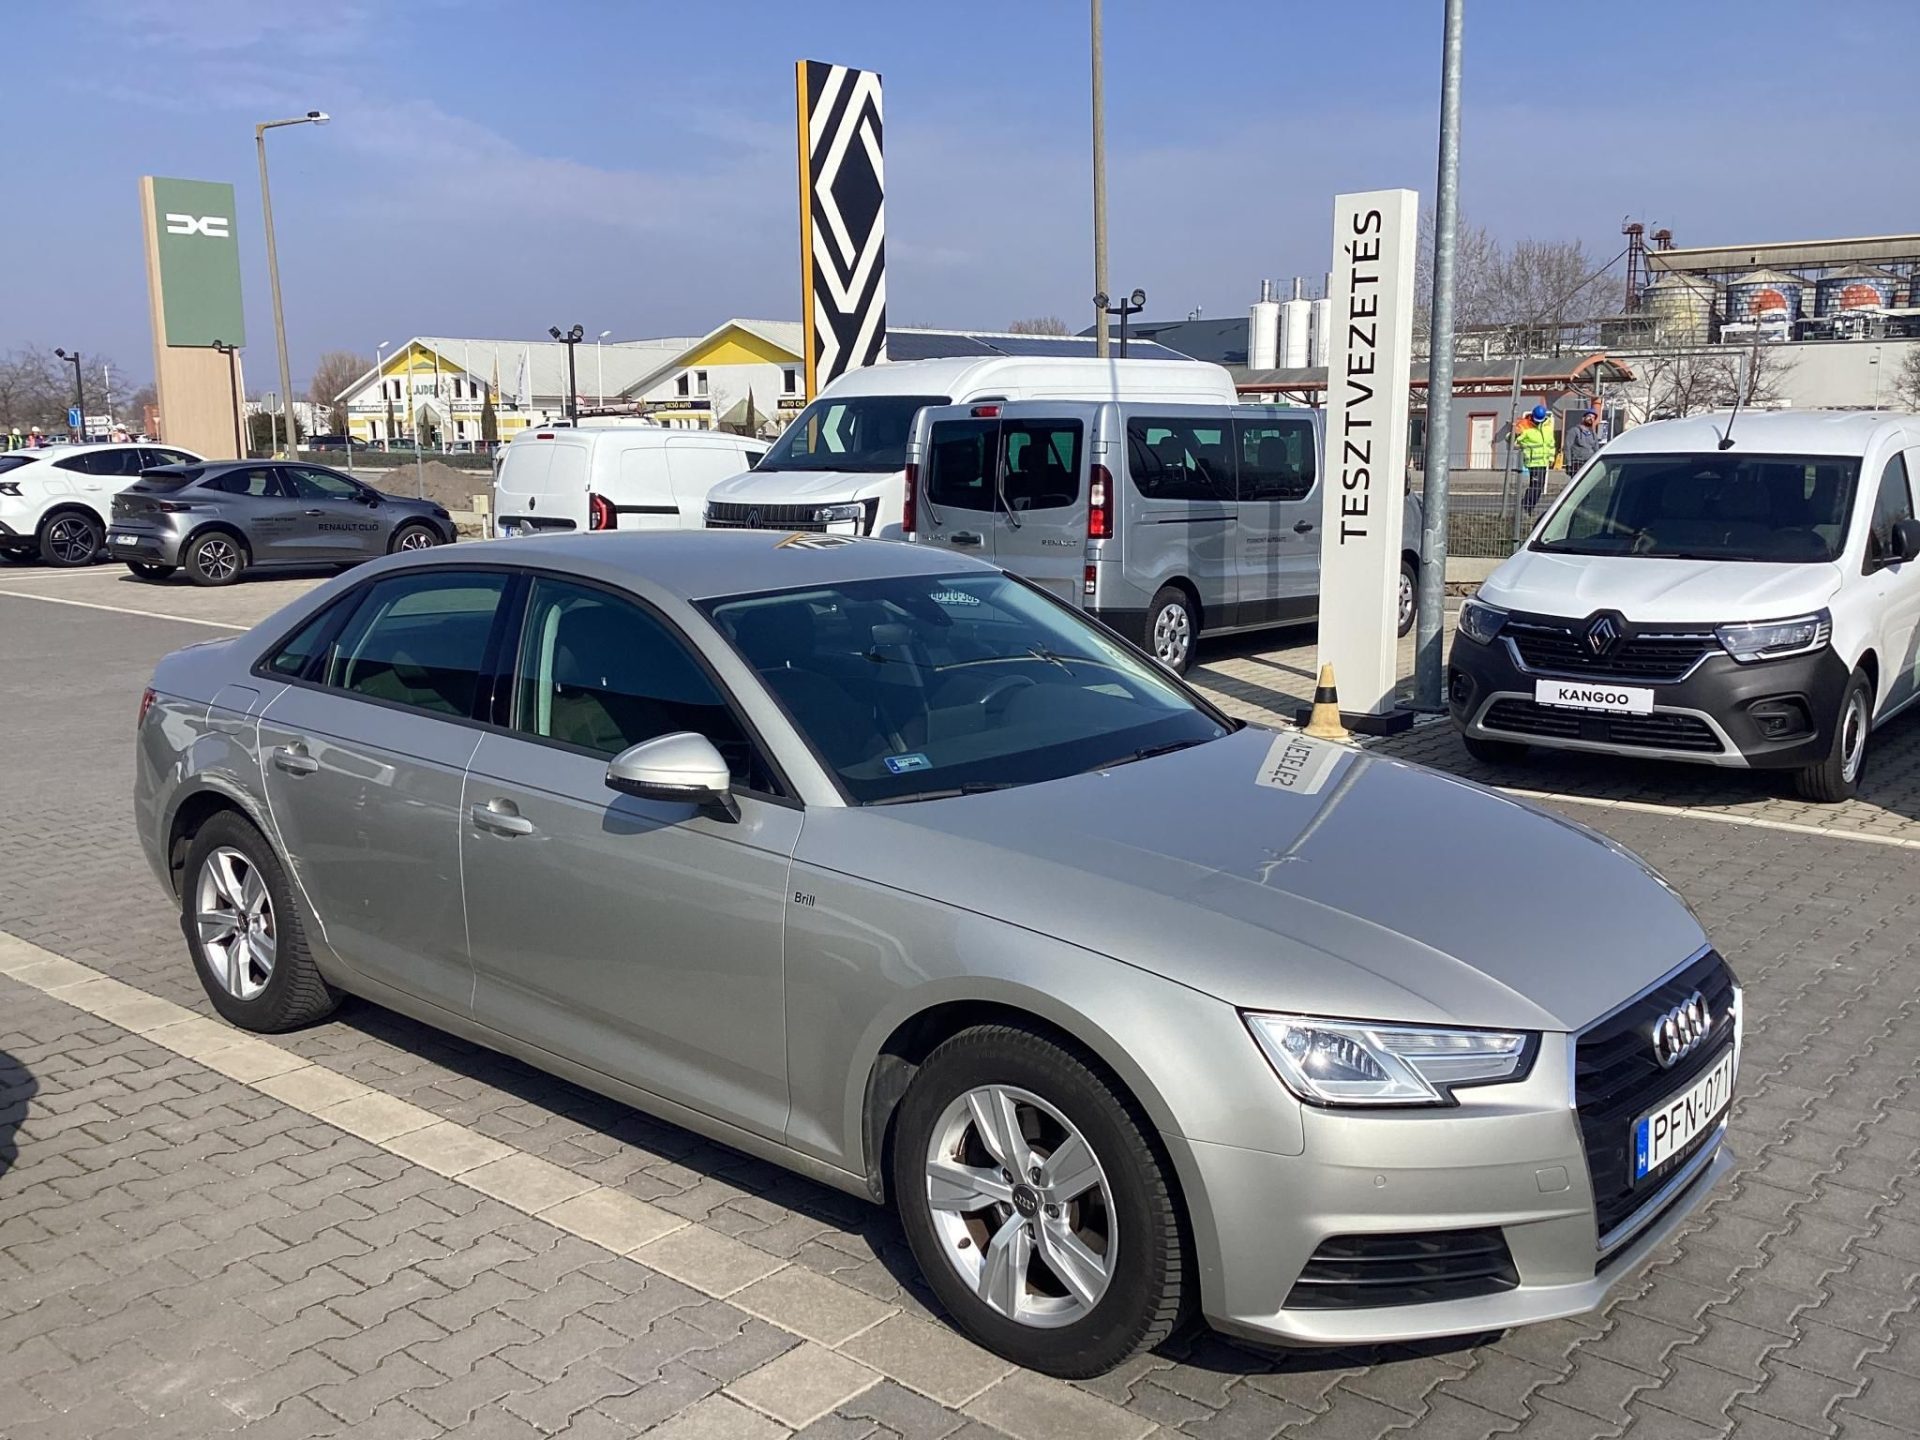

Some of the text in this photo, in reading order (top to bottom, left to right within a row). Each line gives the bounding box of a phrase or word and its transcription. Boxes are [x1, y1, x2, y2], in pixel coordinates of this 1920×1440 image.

[1340, 209, 1382, 545] TESZTVEZETÉS
[318, 523, 379, 532] RENAULT CLIO
[1559, 688, 1629, 705] KANGOO
[794, 891, 816, 907] Brill
[1653, 1059, 1729, 1161] PFN-071
